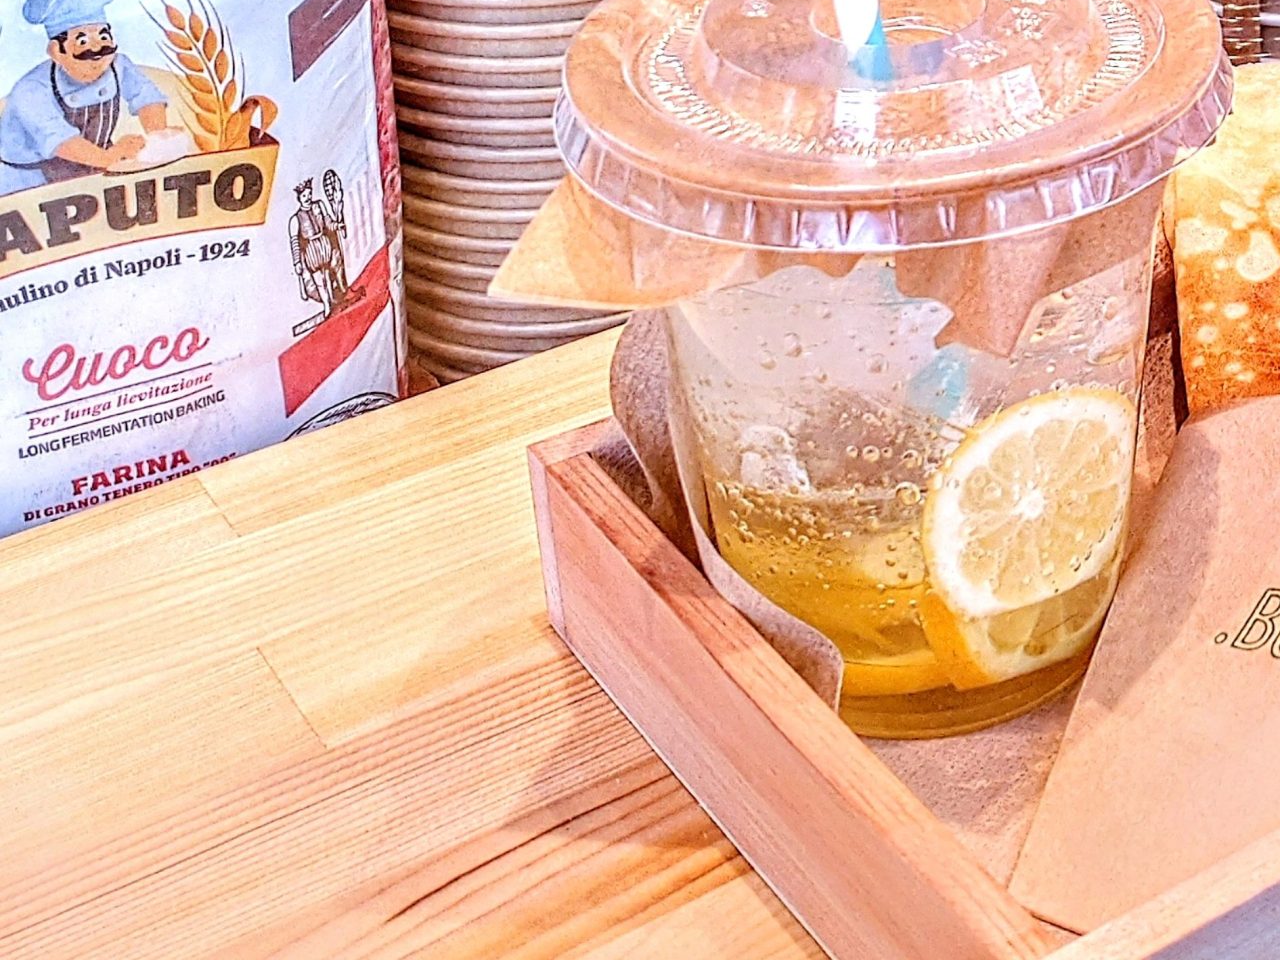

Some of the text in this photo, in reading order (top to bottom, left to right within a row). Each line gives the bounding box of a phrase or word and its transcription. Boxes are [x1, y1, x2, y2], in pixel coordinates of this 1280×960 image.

[74, 266, 98, 289] di
[104, 248, 182, 283] Napoli
[199, 239, 251, 262] 1924
[22, 327, 210, 401] Cuoco
[18, 390, 226, 459] LONG FERMENTATION BAKING
[27, 371, 213, 431] Per lunga lievitazione
[71, 449, 191, 496] FARINA
[23, 510, 41, 522] DI
[44, 495, 100, 517] GRANO
